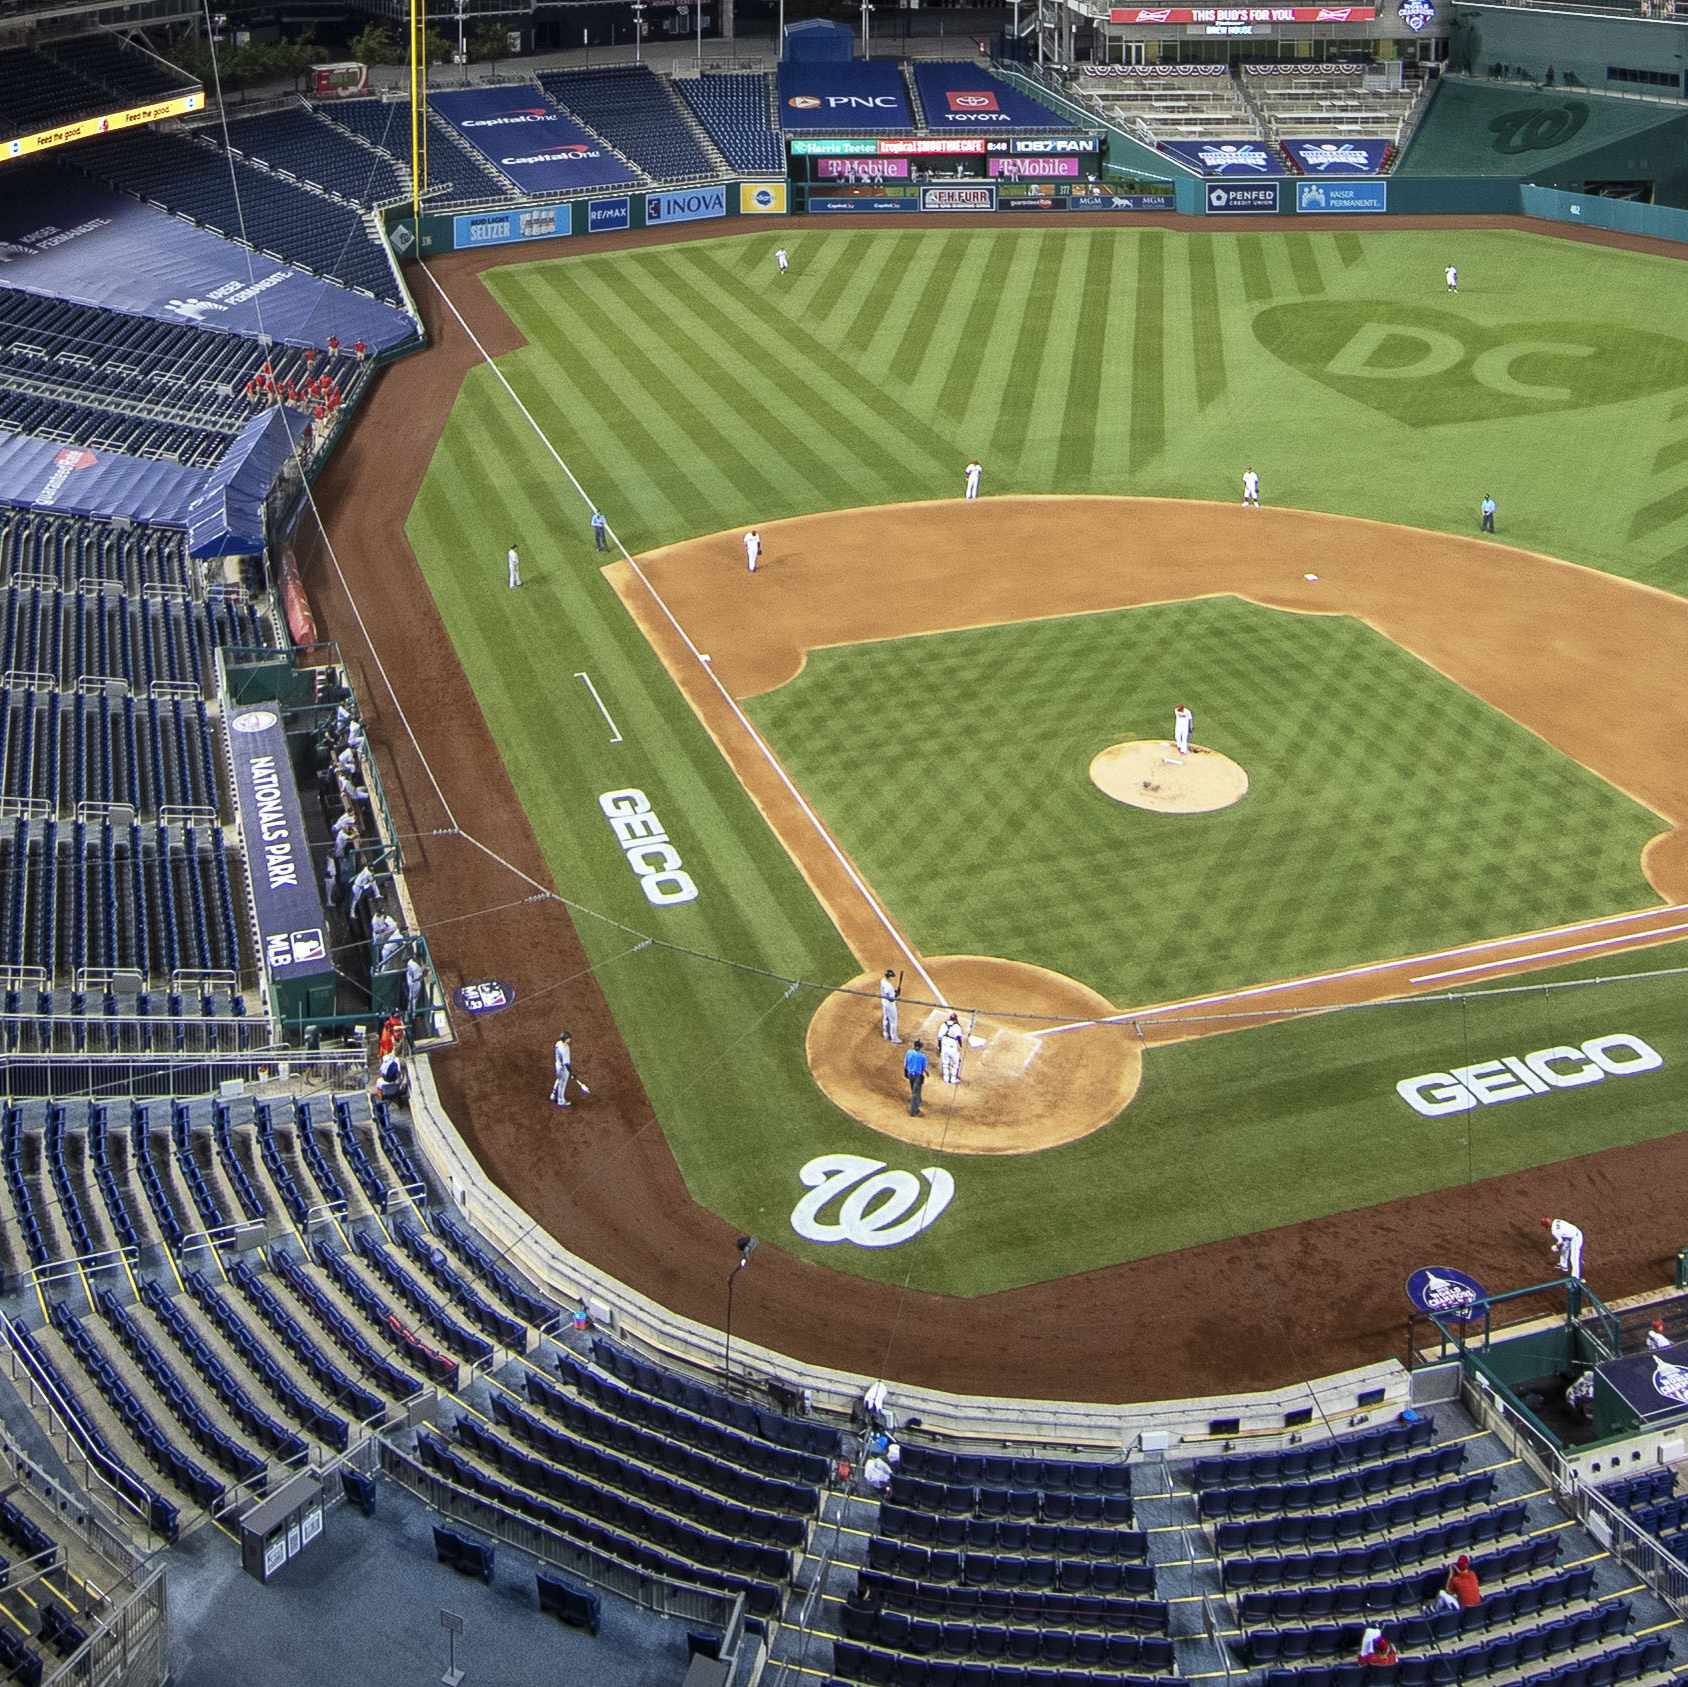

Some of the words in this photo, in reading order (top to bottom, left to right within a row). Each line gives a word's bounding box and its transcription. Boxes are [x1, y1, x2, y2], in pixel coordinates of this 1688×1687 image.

[1192, 10, 1215, 21] THIS
[1217, 10, 1246, 21] BUD'S
[1248, 10, 1268, 21] FOR
[1271, 9, 1294, 20] YOU.
[826, 96, 897, 107] PNC
[1057, 141, 1093, 151] FAN
[1230, 191, 1274, 200] PENFED
[1331, 191, 1354, 199] KAISER
[591, 208, 626, 220] RE/MAX
[666, 195, 724, 215] INOVA
[487, 217, 510, 225] LIGHT
[471, 225, 510, 241] SELTZER
[206, 280, 245, 300] KAISER
[224, 269, 294, 305] PERMANENTE
[250, 755, 290, 843] NATIONALS
[599, 787, 699, 905] GEICO
[263, 843, 297, 889] PARK
[266, 933, 292, 967] MLB
[1395, 1032, 1664, 1117] GEICO
